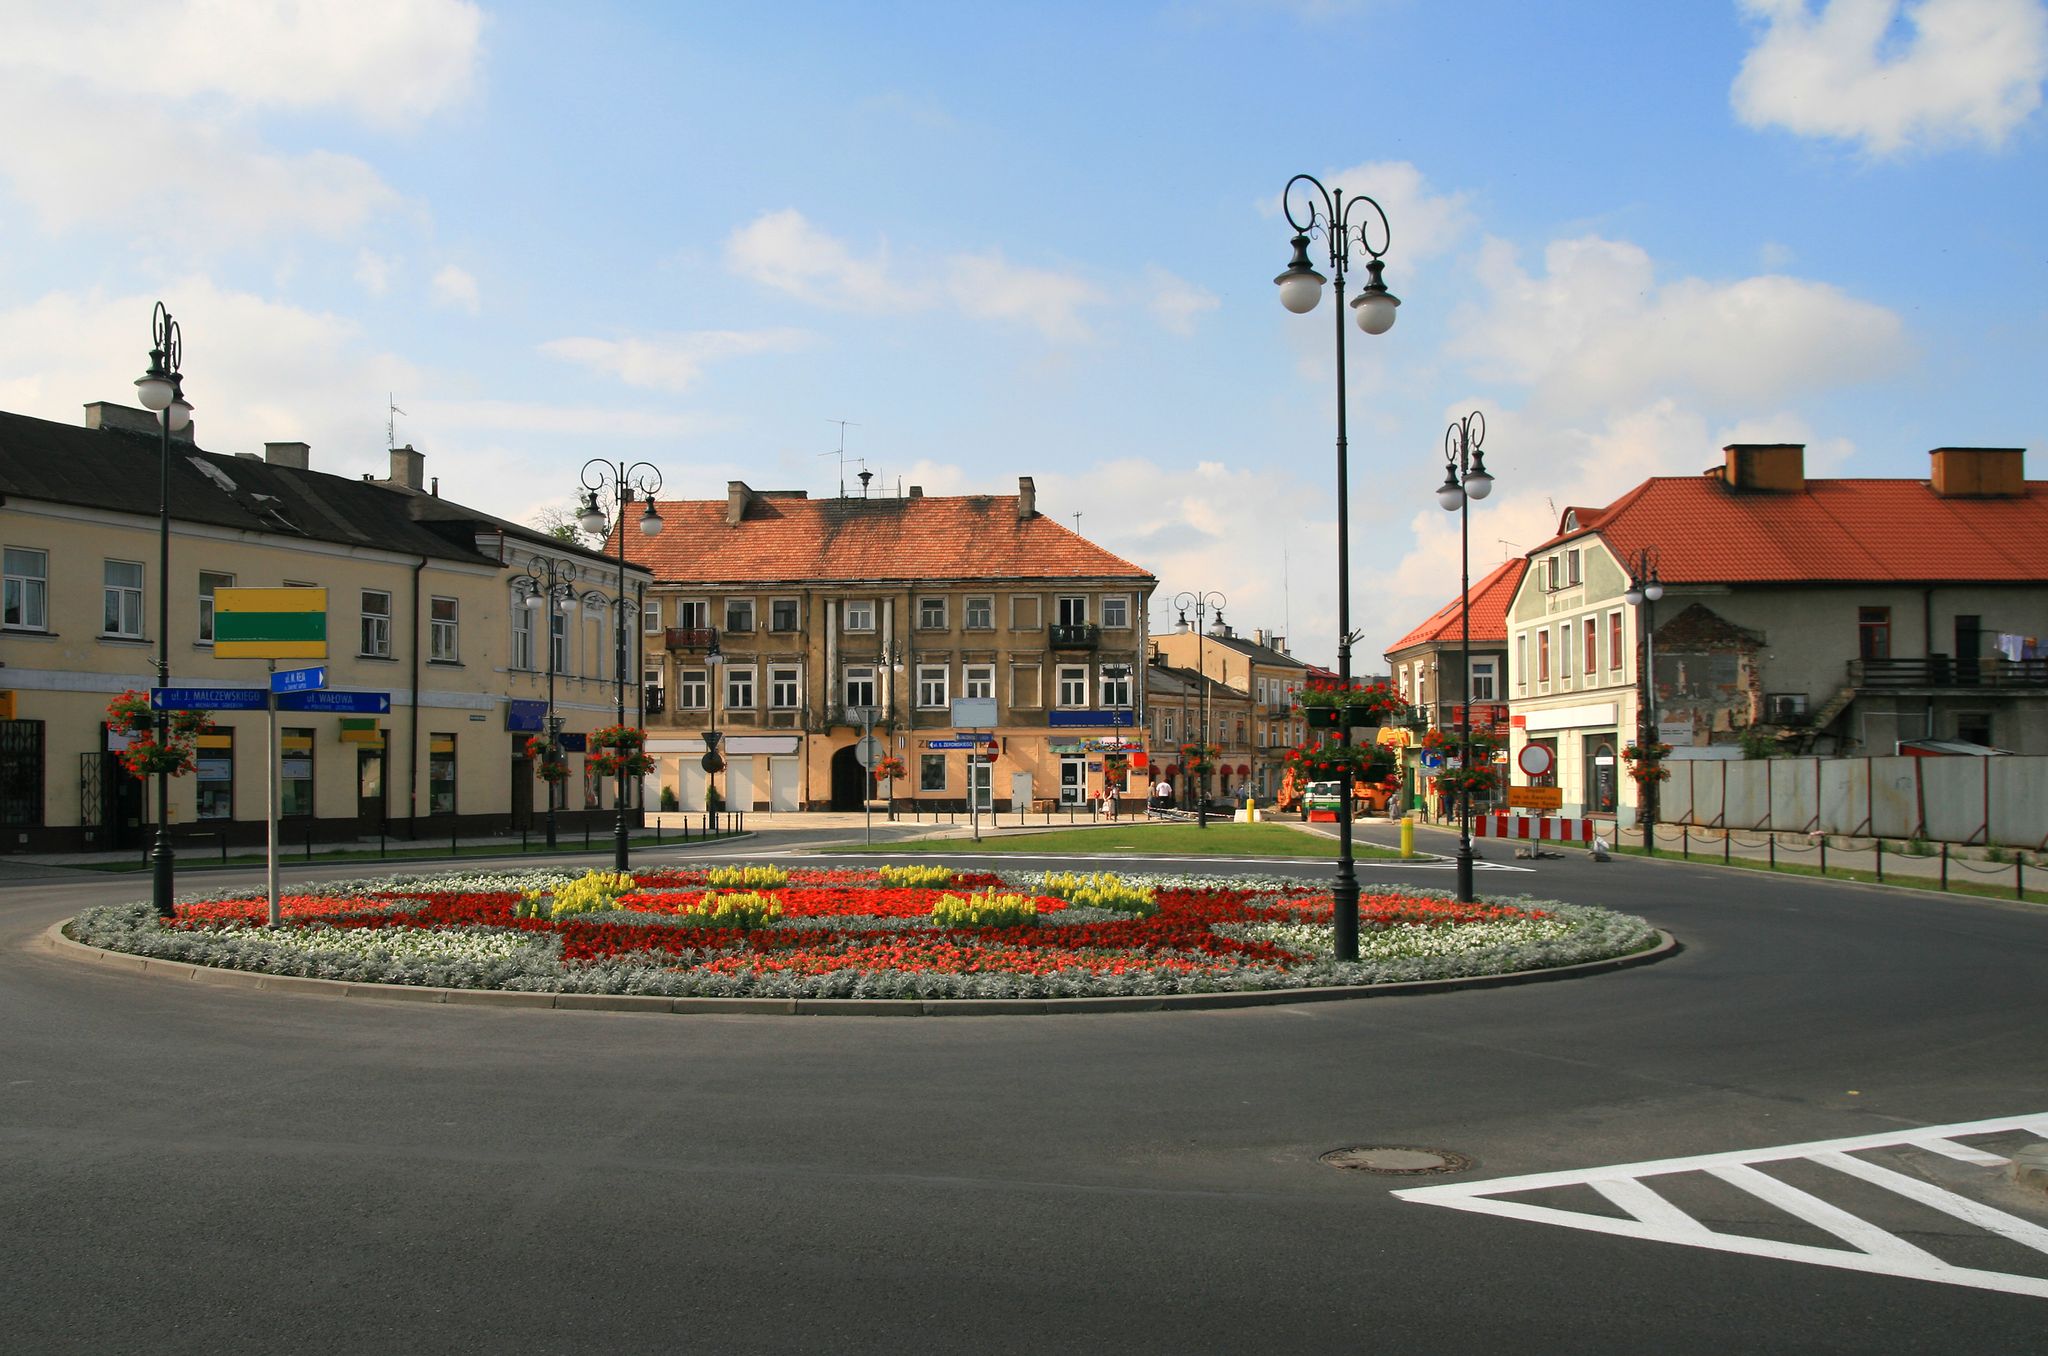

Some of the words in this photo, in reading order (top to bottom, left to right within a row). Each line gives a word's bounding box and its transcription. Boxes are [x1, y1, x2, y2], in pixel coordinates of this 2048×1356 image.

[171, 691, 181, 700] ul.
[193, 691, 260, 702] MALCZEWSKIEGO
[306, 693, 316, 703] ul.
[319, 693, 353, 704] WAŁOWA
